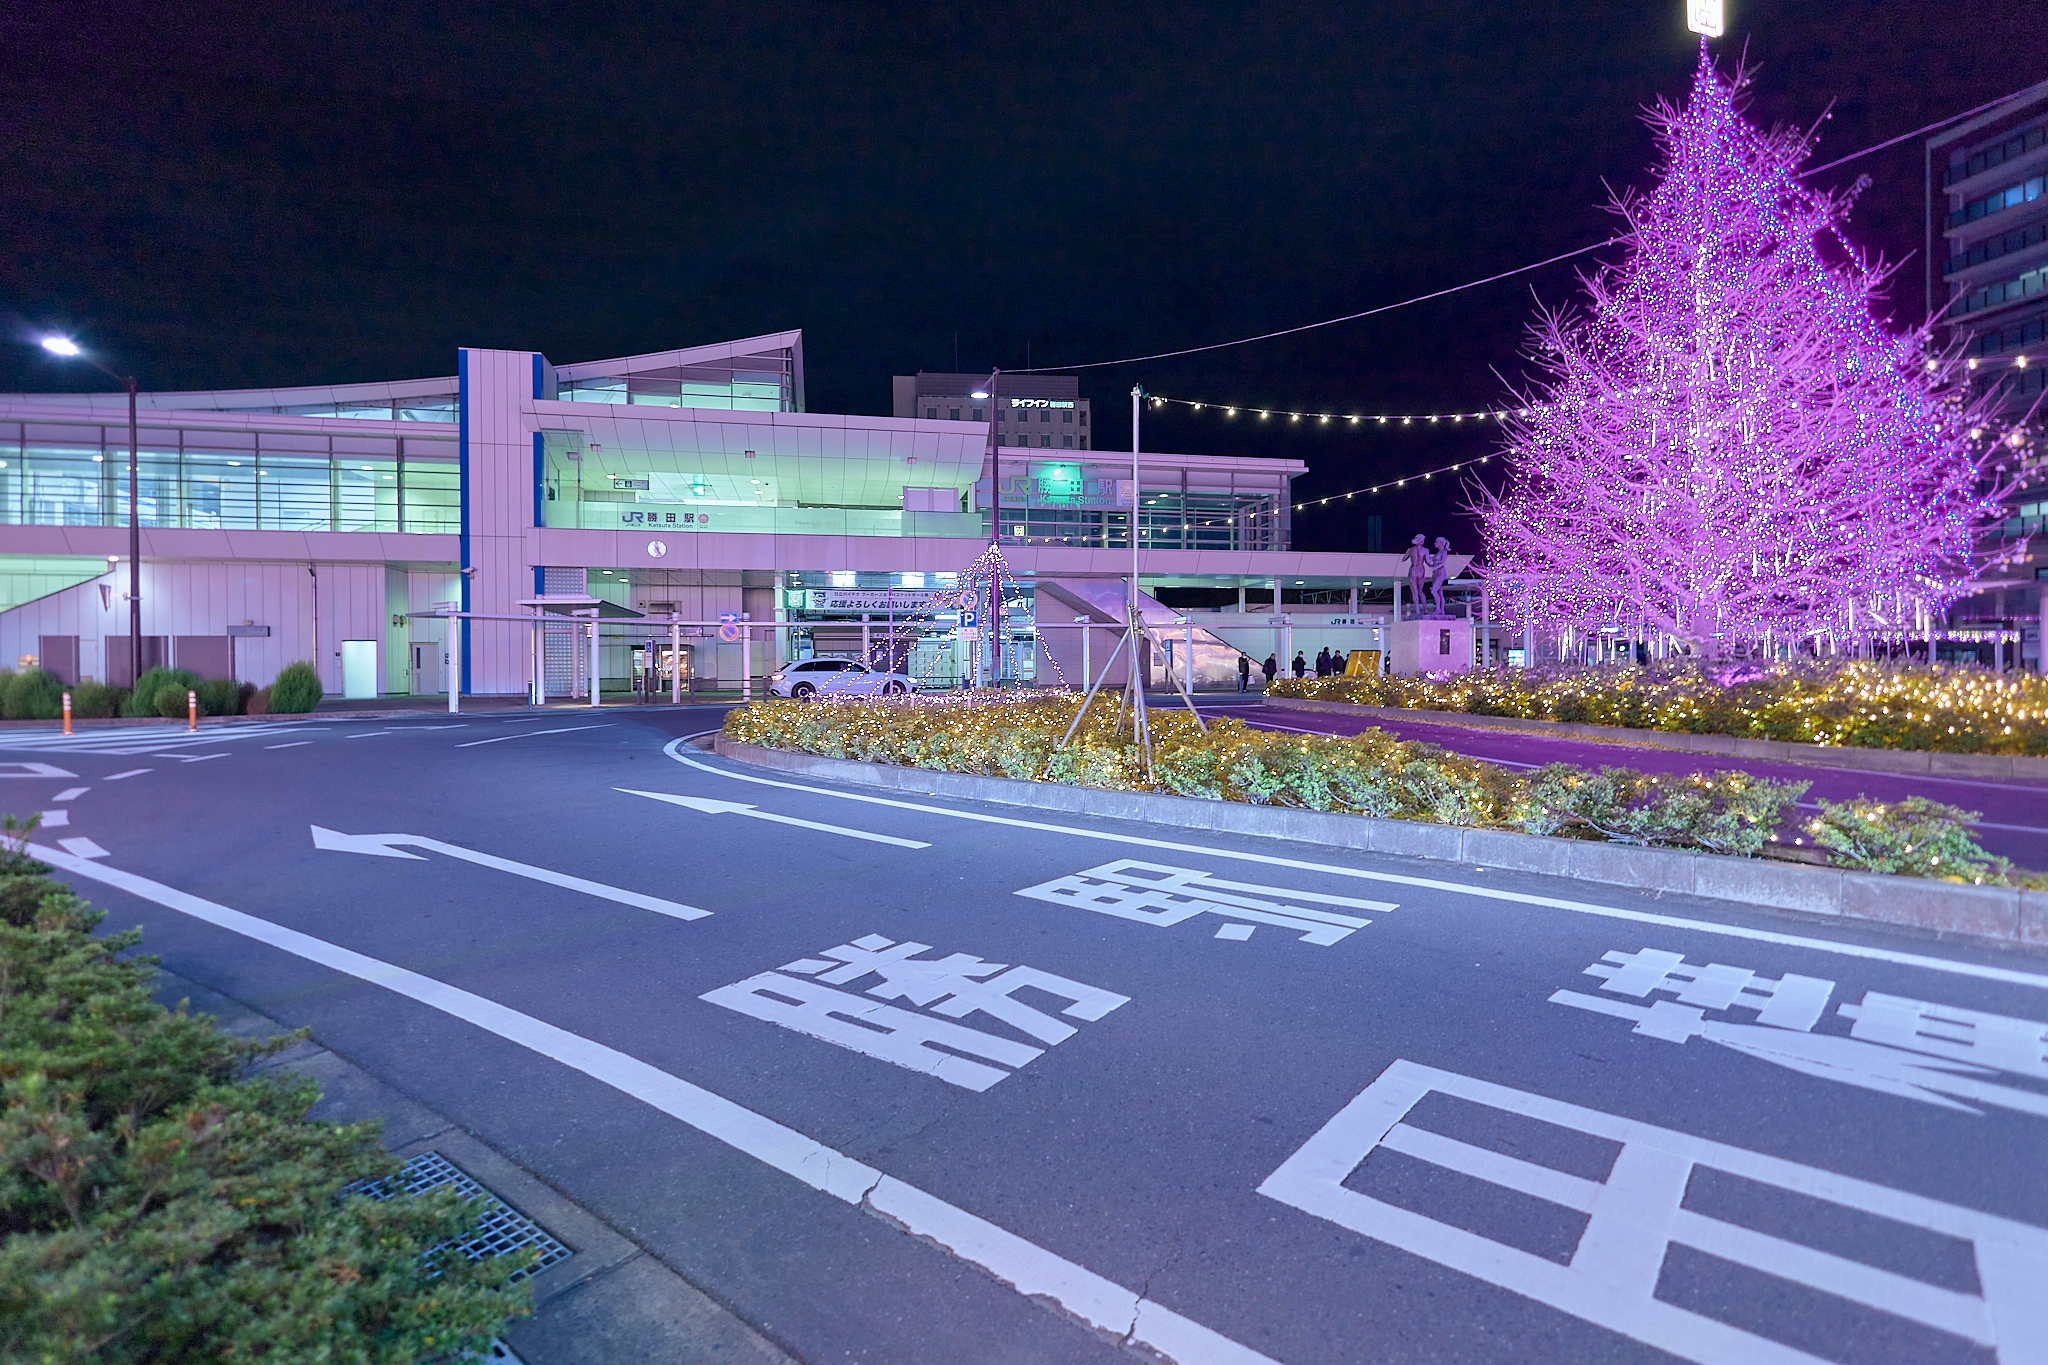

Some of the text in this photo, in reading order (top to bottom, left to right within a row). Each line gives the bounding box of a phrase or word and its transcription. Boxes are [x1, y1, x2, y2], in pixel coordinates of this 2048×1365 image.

[1011, 399, 1049, 408] ライフイン
[998, 475, 1113, 495] JR 勝田駅
[1078, 496, 1111, 505] Station
[622, 512, 694, 523] JR 勝田駅
[964, 612, 975, 627] P
